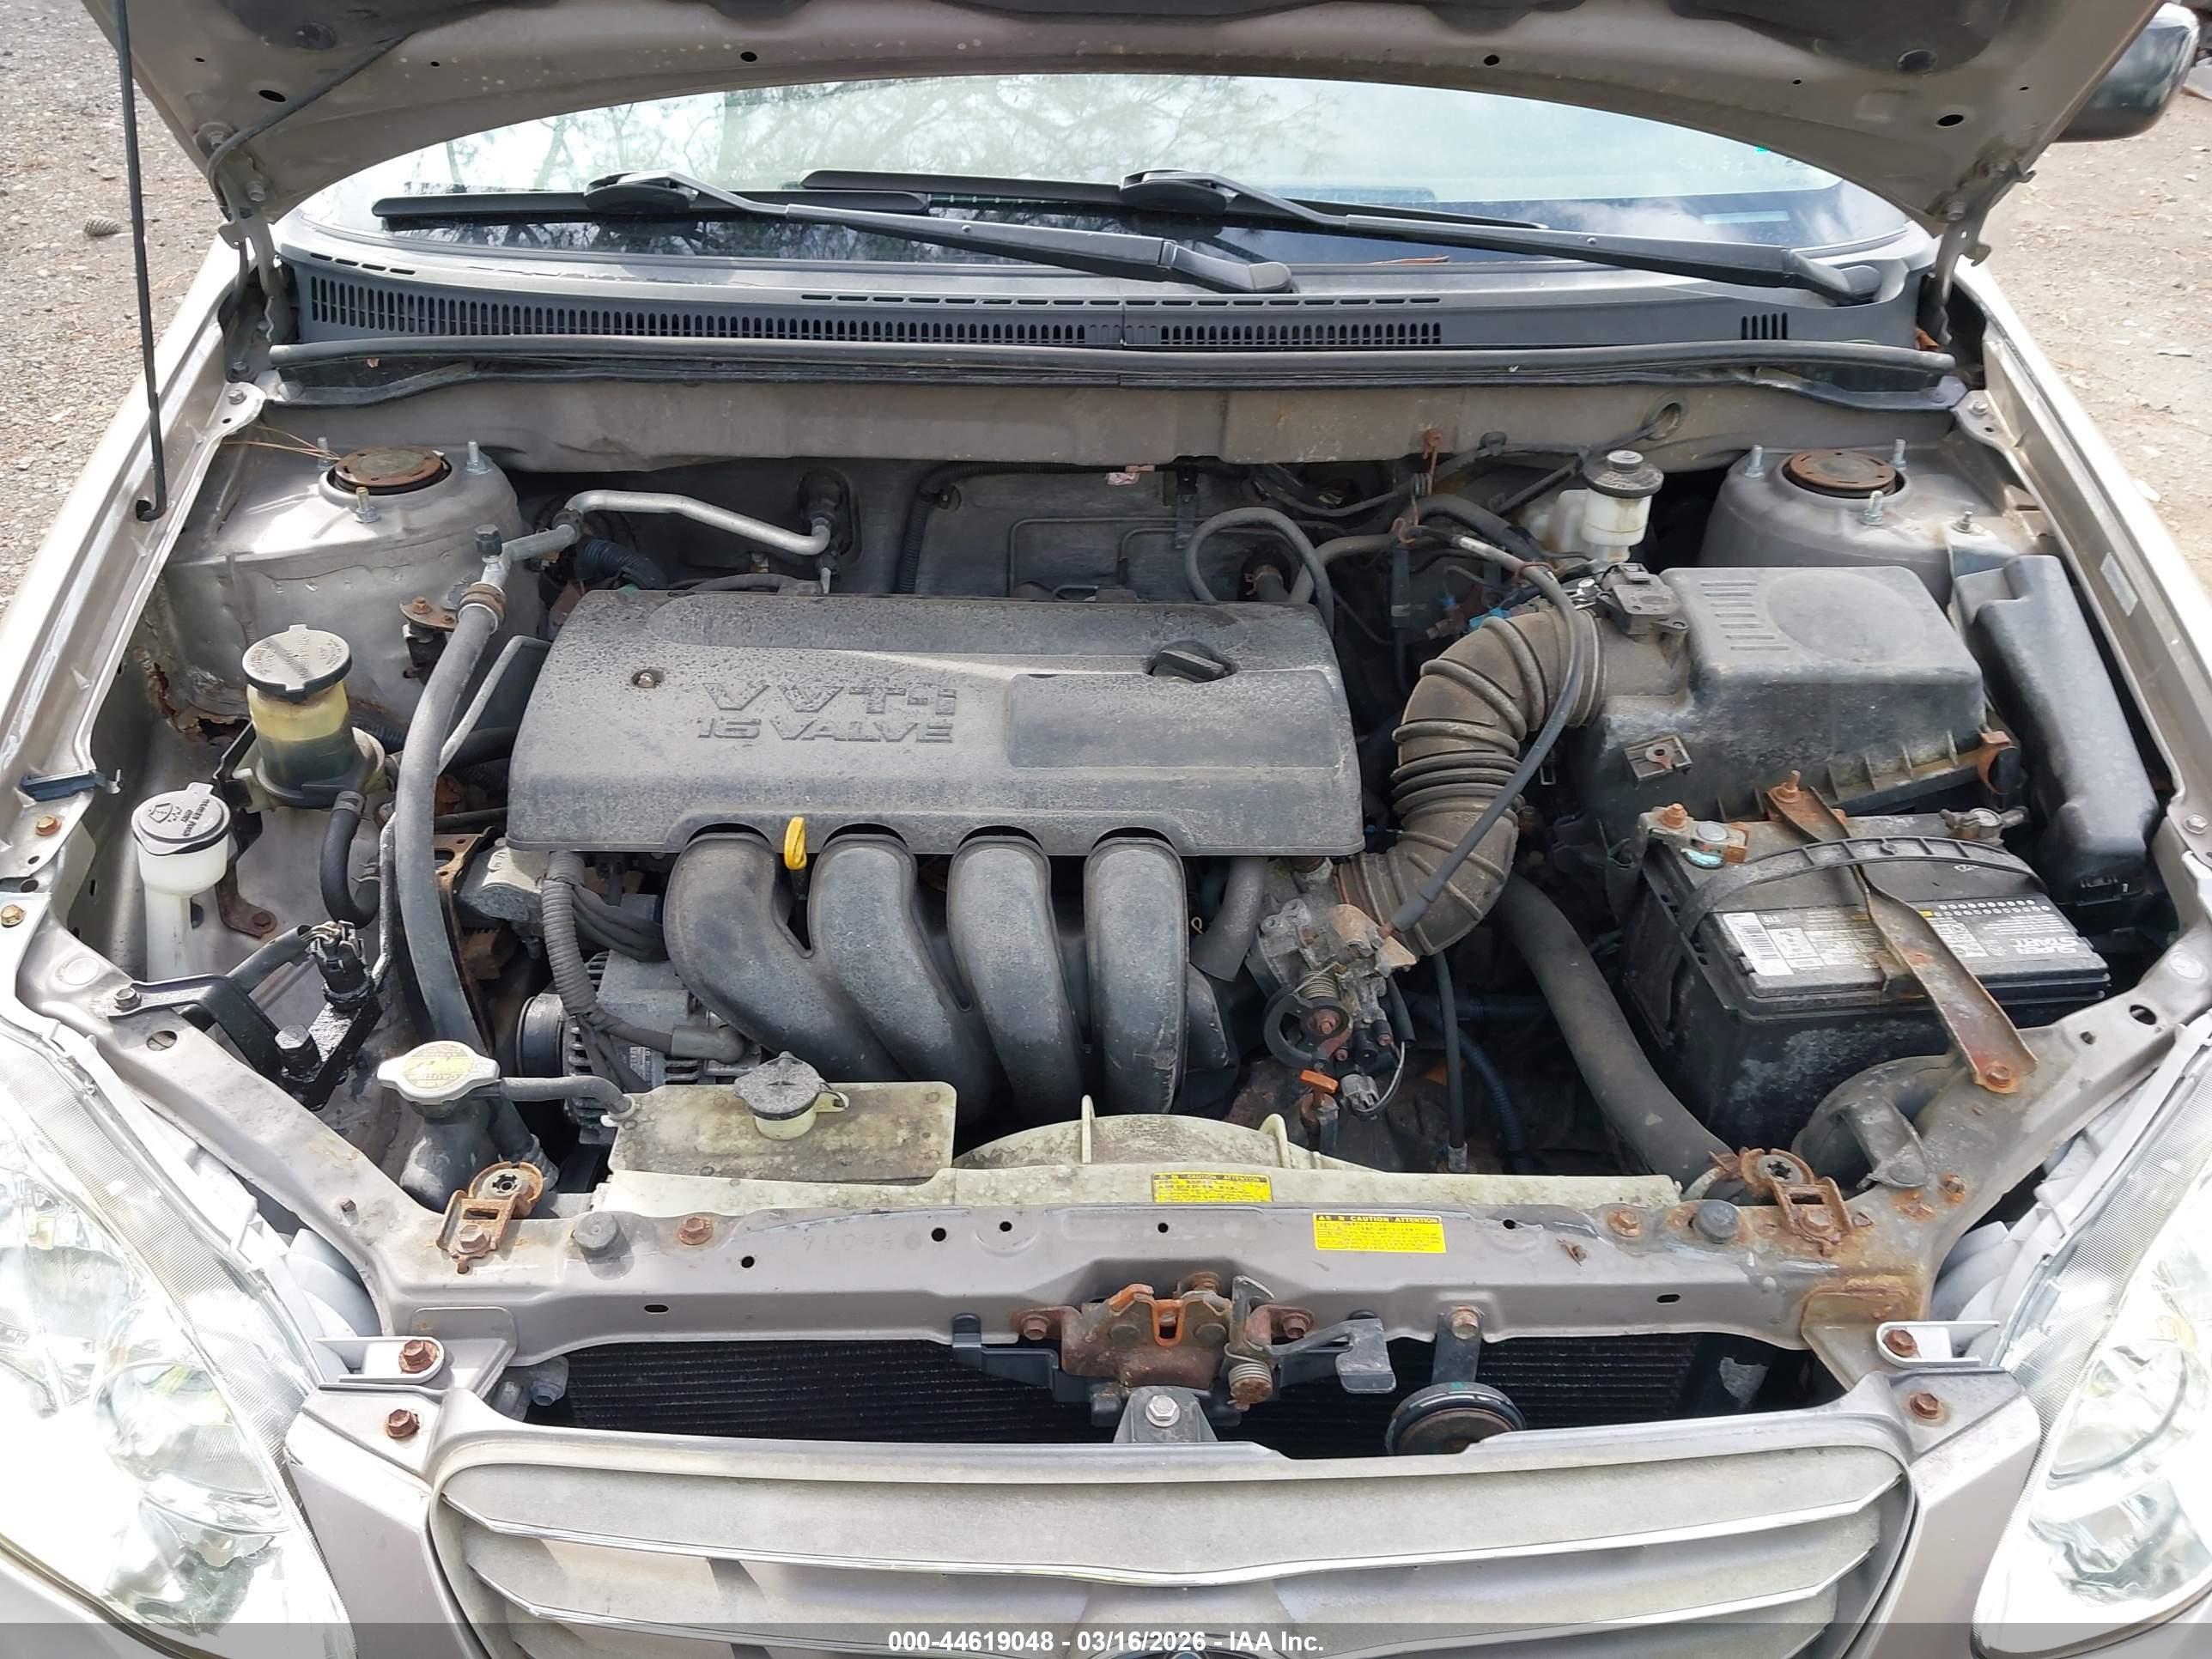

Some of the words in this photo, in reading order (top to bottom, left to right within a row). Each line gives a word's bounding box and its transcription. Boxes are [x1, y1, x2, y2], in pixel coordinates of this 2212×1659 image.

[697, 717, 762, 739] 16
[769, 719, 954, 744] VALVE
[2009, 936, 2078, 947] START
[2015, 945, 2077, 954] SUPER
